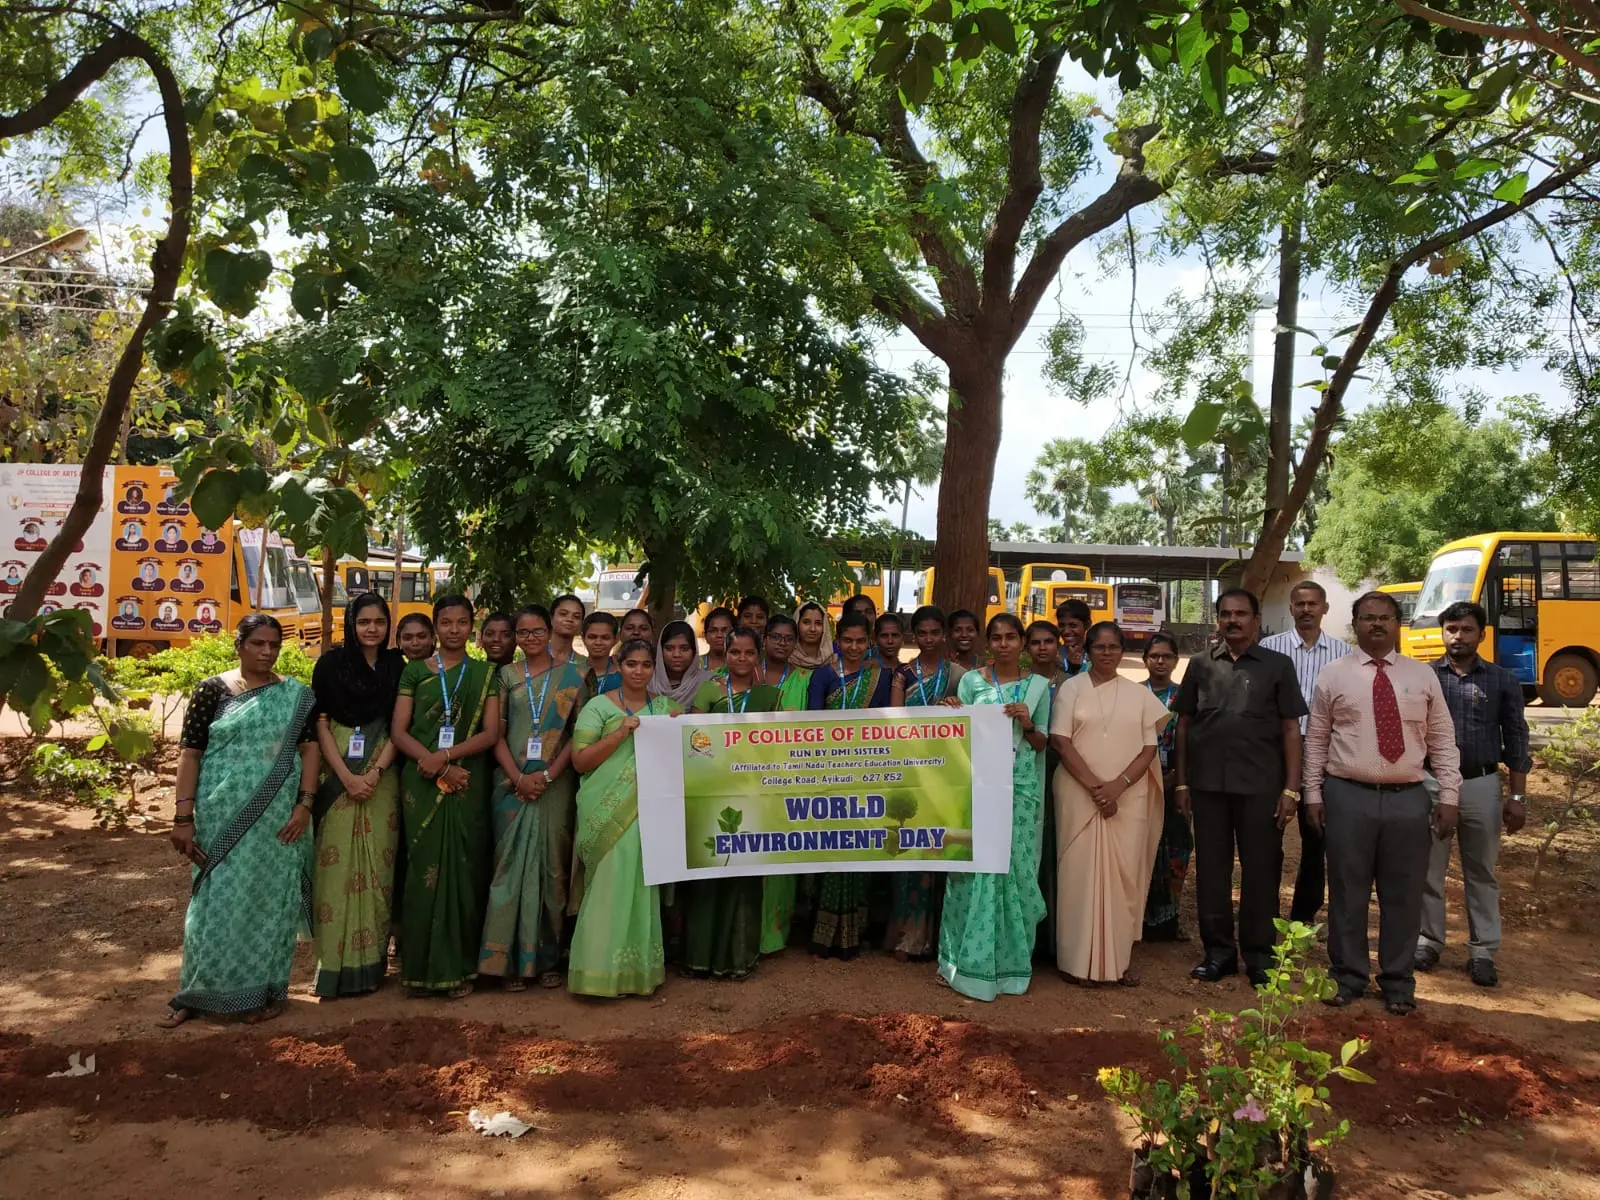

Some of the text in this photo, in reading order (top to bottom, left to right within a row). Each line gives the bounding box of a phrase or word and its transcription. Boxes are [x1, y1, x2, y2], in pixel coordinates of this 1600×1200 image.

[724, 723, 965, 747] JP COLLEGE OF EDUCATION
[790, 747, 891, 758] RUN BY DMI SISTERS
[731, 758, 946, 772] (Affiliated to Tamil Nadu Teachers Education University)
[762, 776, 793, 786] College
[795, 776, 819, 785] Road,
[822, 774, 853, 785] Ayikudi
[862, 773, 881, 782] 627
[884, 772, 902, 782] 852
[785, 795, 885, 821] WORLD
[716, 828, 946, 855] ENVIRONMENT DAY
